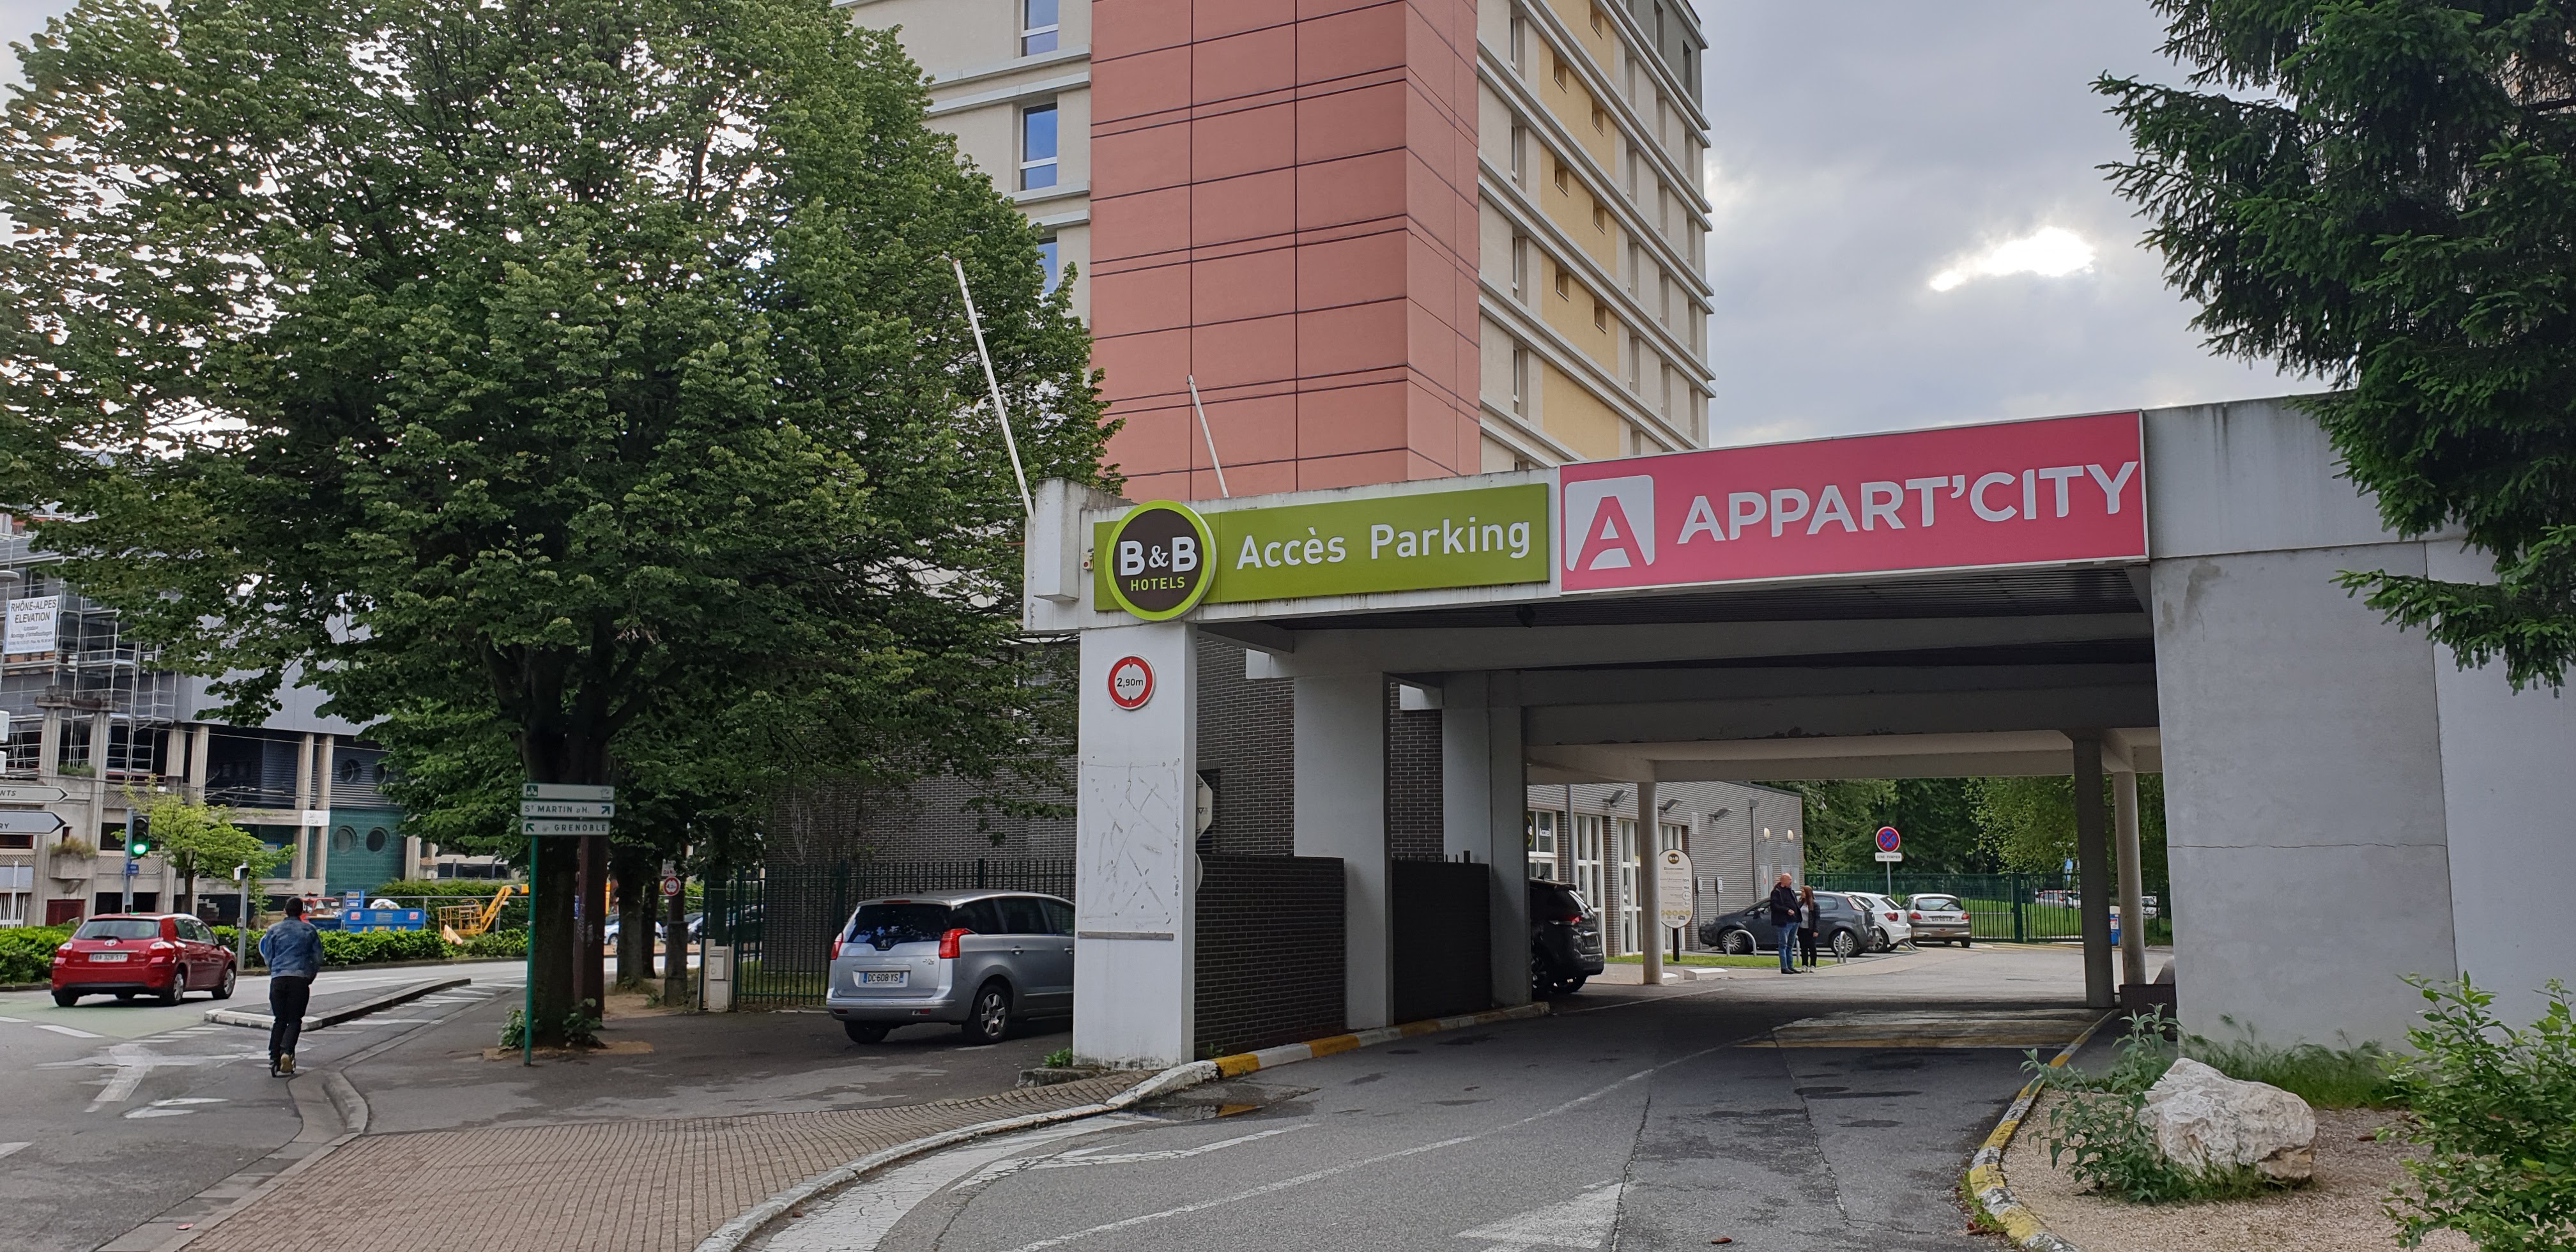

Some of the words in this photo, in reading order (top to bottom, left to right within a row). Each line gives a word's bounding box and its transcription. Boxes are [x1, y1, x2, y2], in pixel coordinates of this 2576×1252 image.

[1676, 460, 2139, 544] APPART'CITY
[1236, 526, 1346, 570] Accès
[1370, 516, 1530, 560] Parking
[1120, 536, 1197, 576] B&B
[1130, 576, 1185, 592] HOTELS
[10, 599, 57, 612] RHÔNE-ALPES
[15, 611, 50, 623] ELEVATION
[1117, 677, 1144, 688] 2,90m
[537, 805, 572, 813] MARTIN
